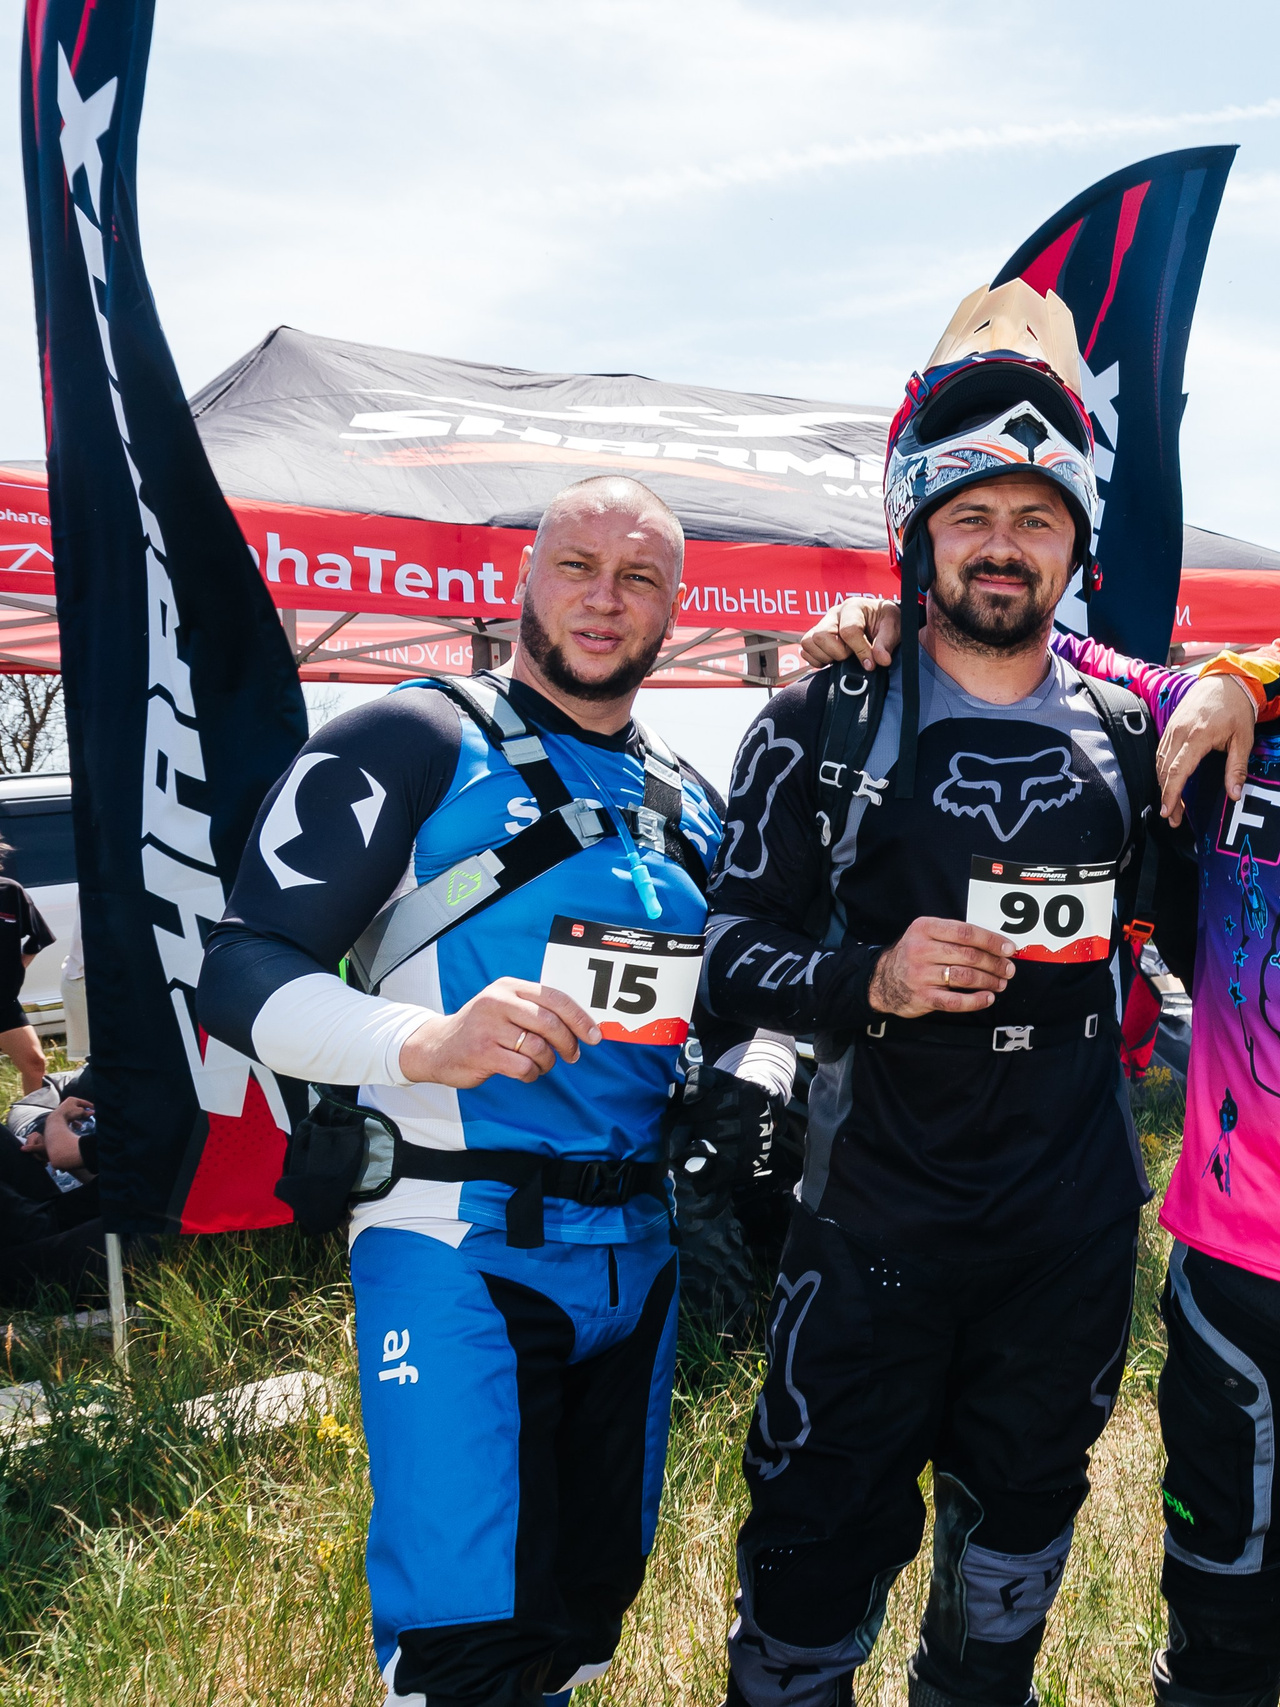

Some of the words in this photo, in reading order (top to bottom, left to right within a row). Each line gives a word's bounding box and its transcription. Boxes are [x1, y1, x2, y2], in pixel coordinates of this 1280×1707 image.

[338, 409, 887, 482] SHARM
[681, 586, 801, 616] ИЛЬНЫЕ
[1019, 871, 1068, 879] SHARMAX
[1000, 891, 1085, 938] 90
[601, 934, 655, 947] SHARMAX
[587, 957, 659, 1015] 15
[725, 942, 836, 990] FOX
